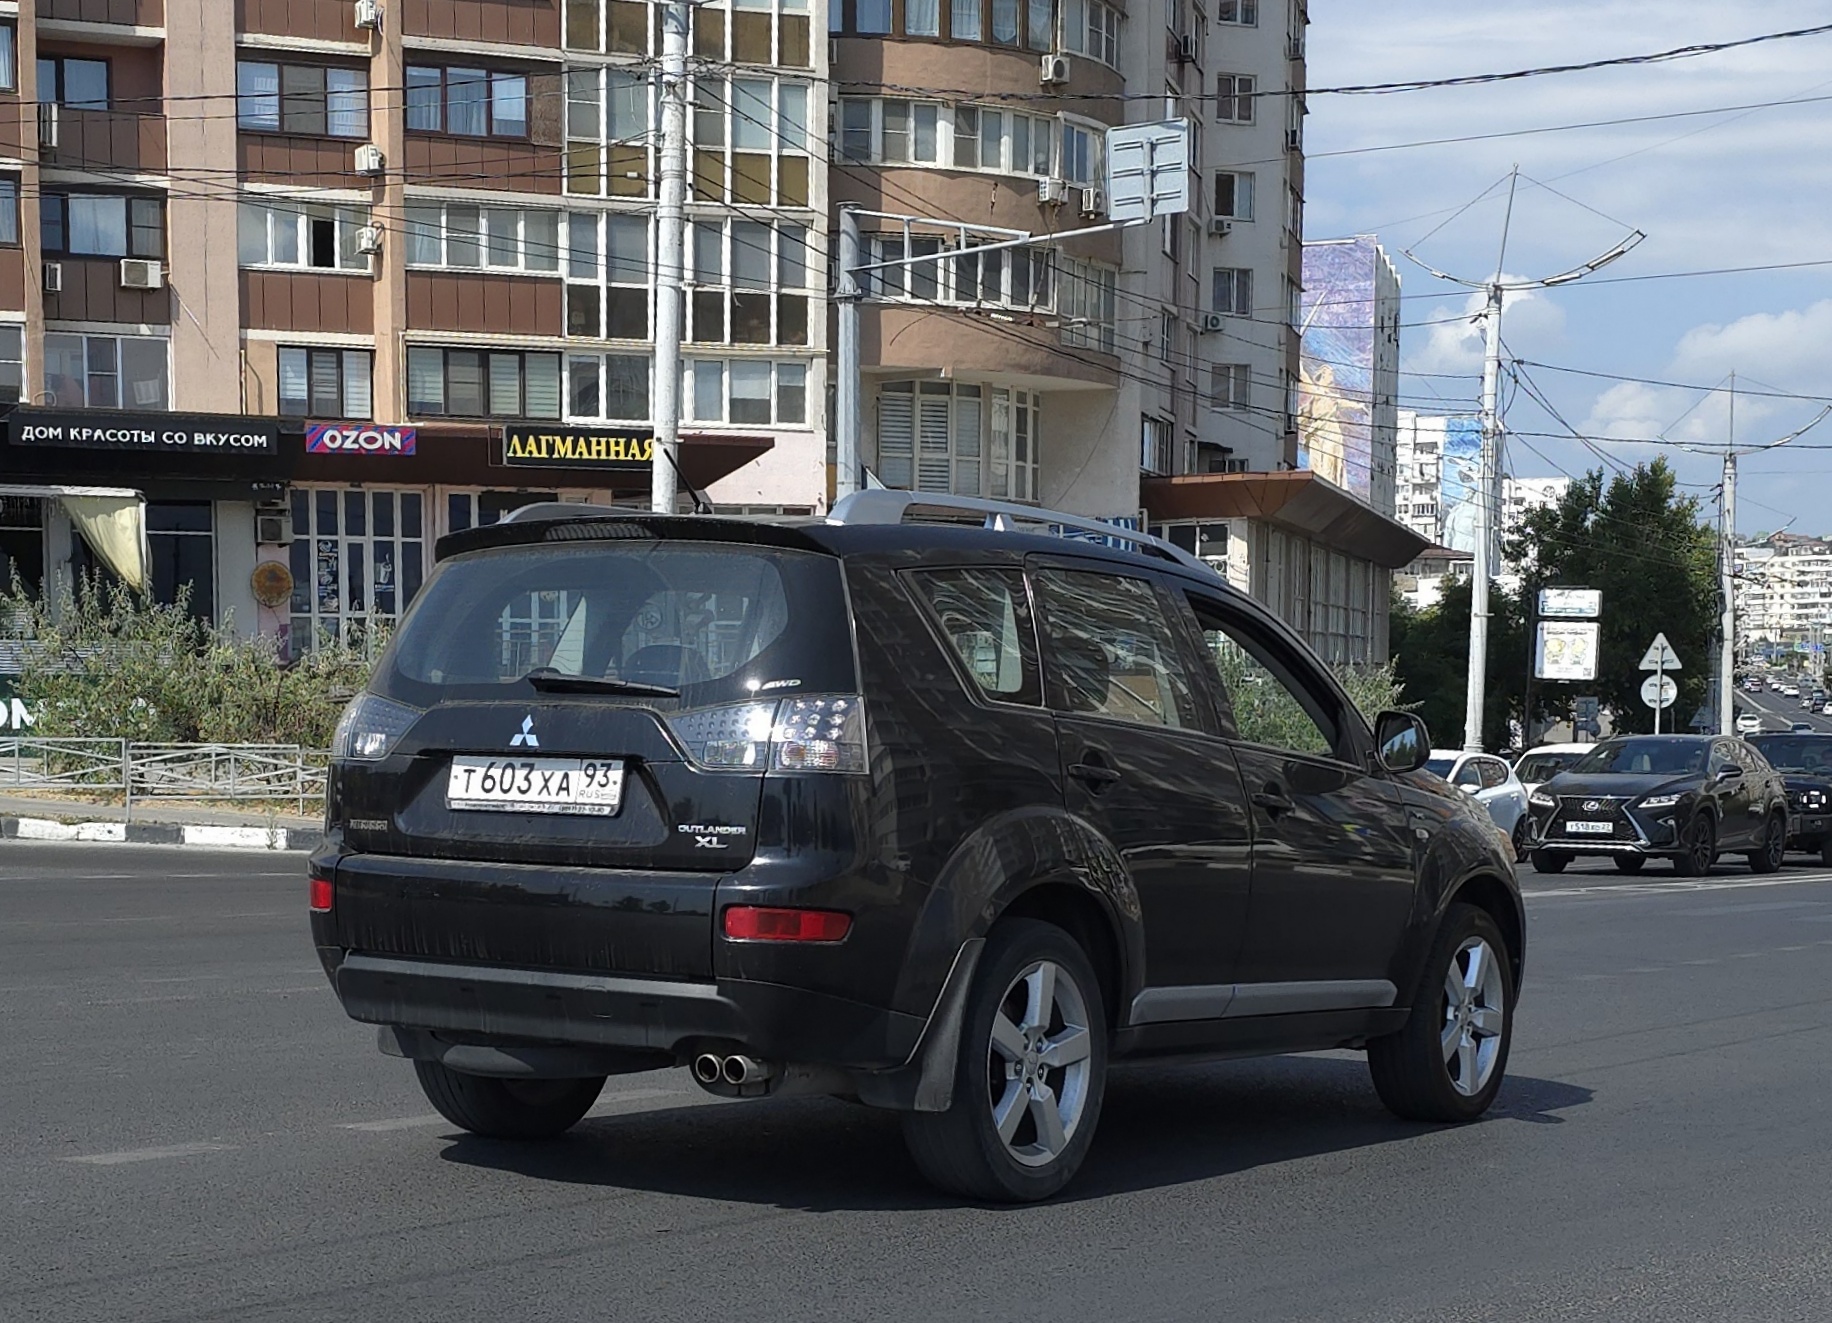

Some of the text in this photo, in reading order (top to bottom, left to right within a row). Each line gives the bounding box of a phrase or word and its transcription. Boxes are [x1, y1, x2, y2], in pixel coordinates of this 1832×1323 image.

[21, 425, 268, 448] ДОМ КРАСОТЫ СО ВКУСОМ
[323, 429, 401, 450] OZON
[507, 434, 653, 461] ЛАГМАННАЯ
[463, 761, 613, 797] Т603ХА 93
[578, 789, 601, 799] RUS
[677, 824, 747, 835] OUTLANDER
[694, 835, 729, 849] XL
